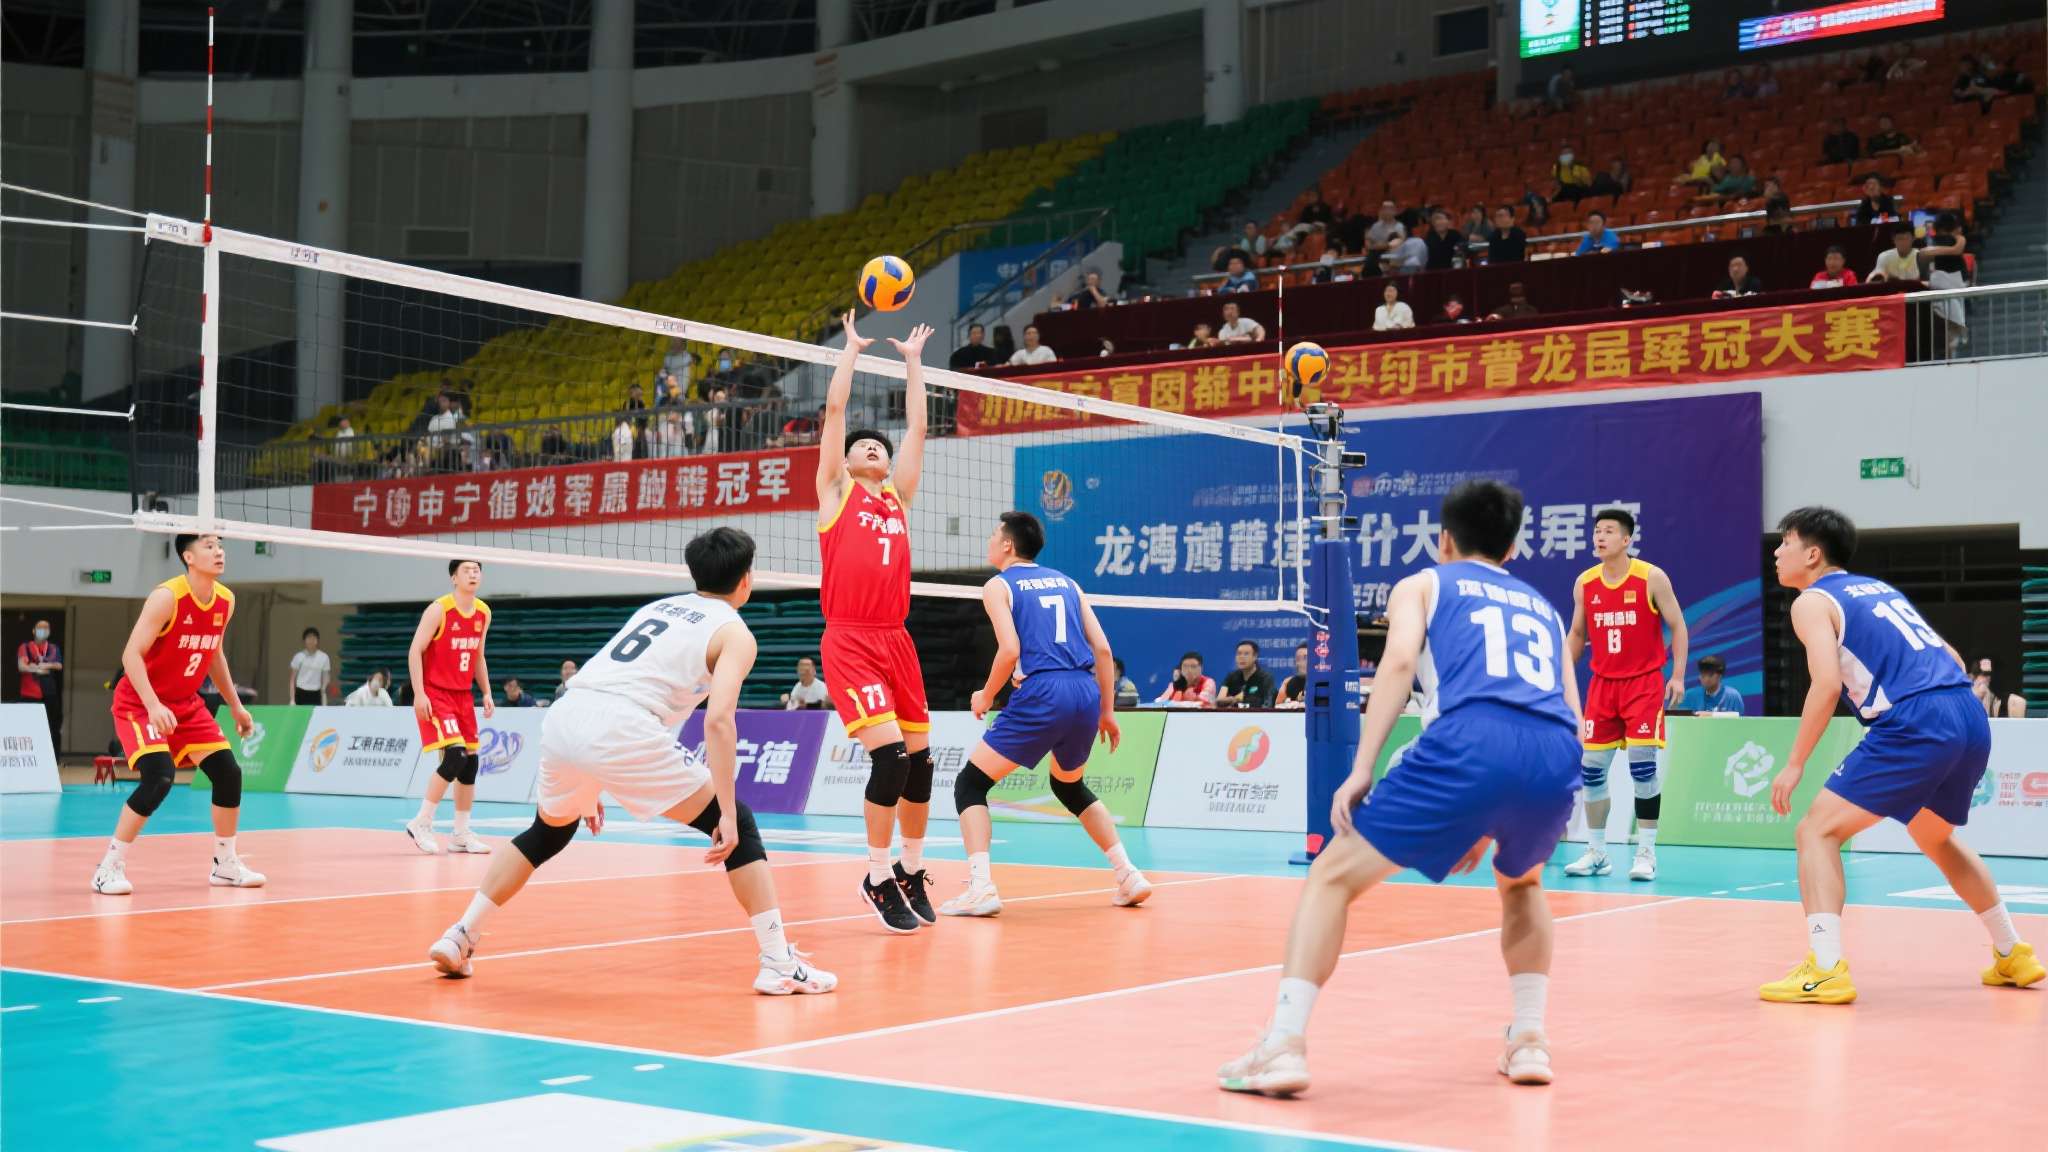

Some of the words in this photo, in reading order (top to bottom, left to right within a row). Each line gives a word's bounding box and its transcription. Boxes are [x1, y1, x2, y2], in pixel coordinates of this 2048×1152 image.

[878, 537, 891, 566] 7
[610, 618, 669, 662] 6
[1039, 595, 1067, 643] 7
[1872, 598, 1943, 651] 19
[1470, 606, 1556, 691] 13
